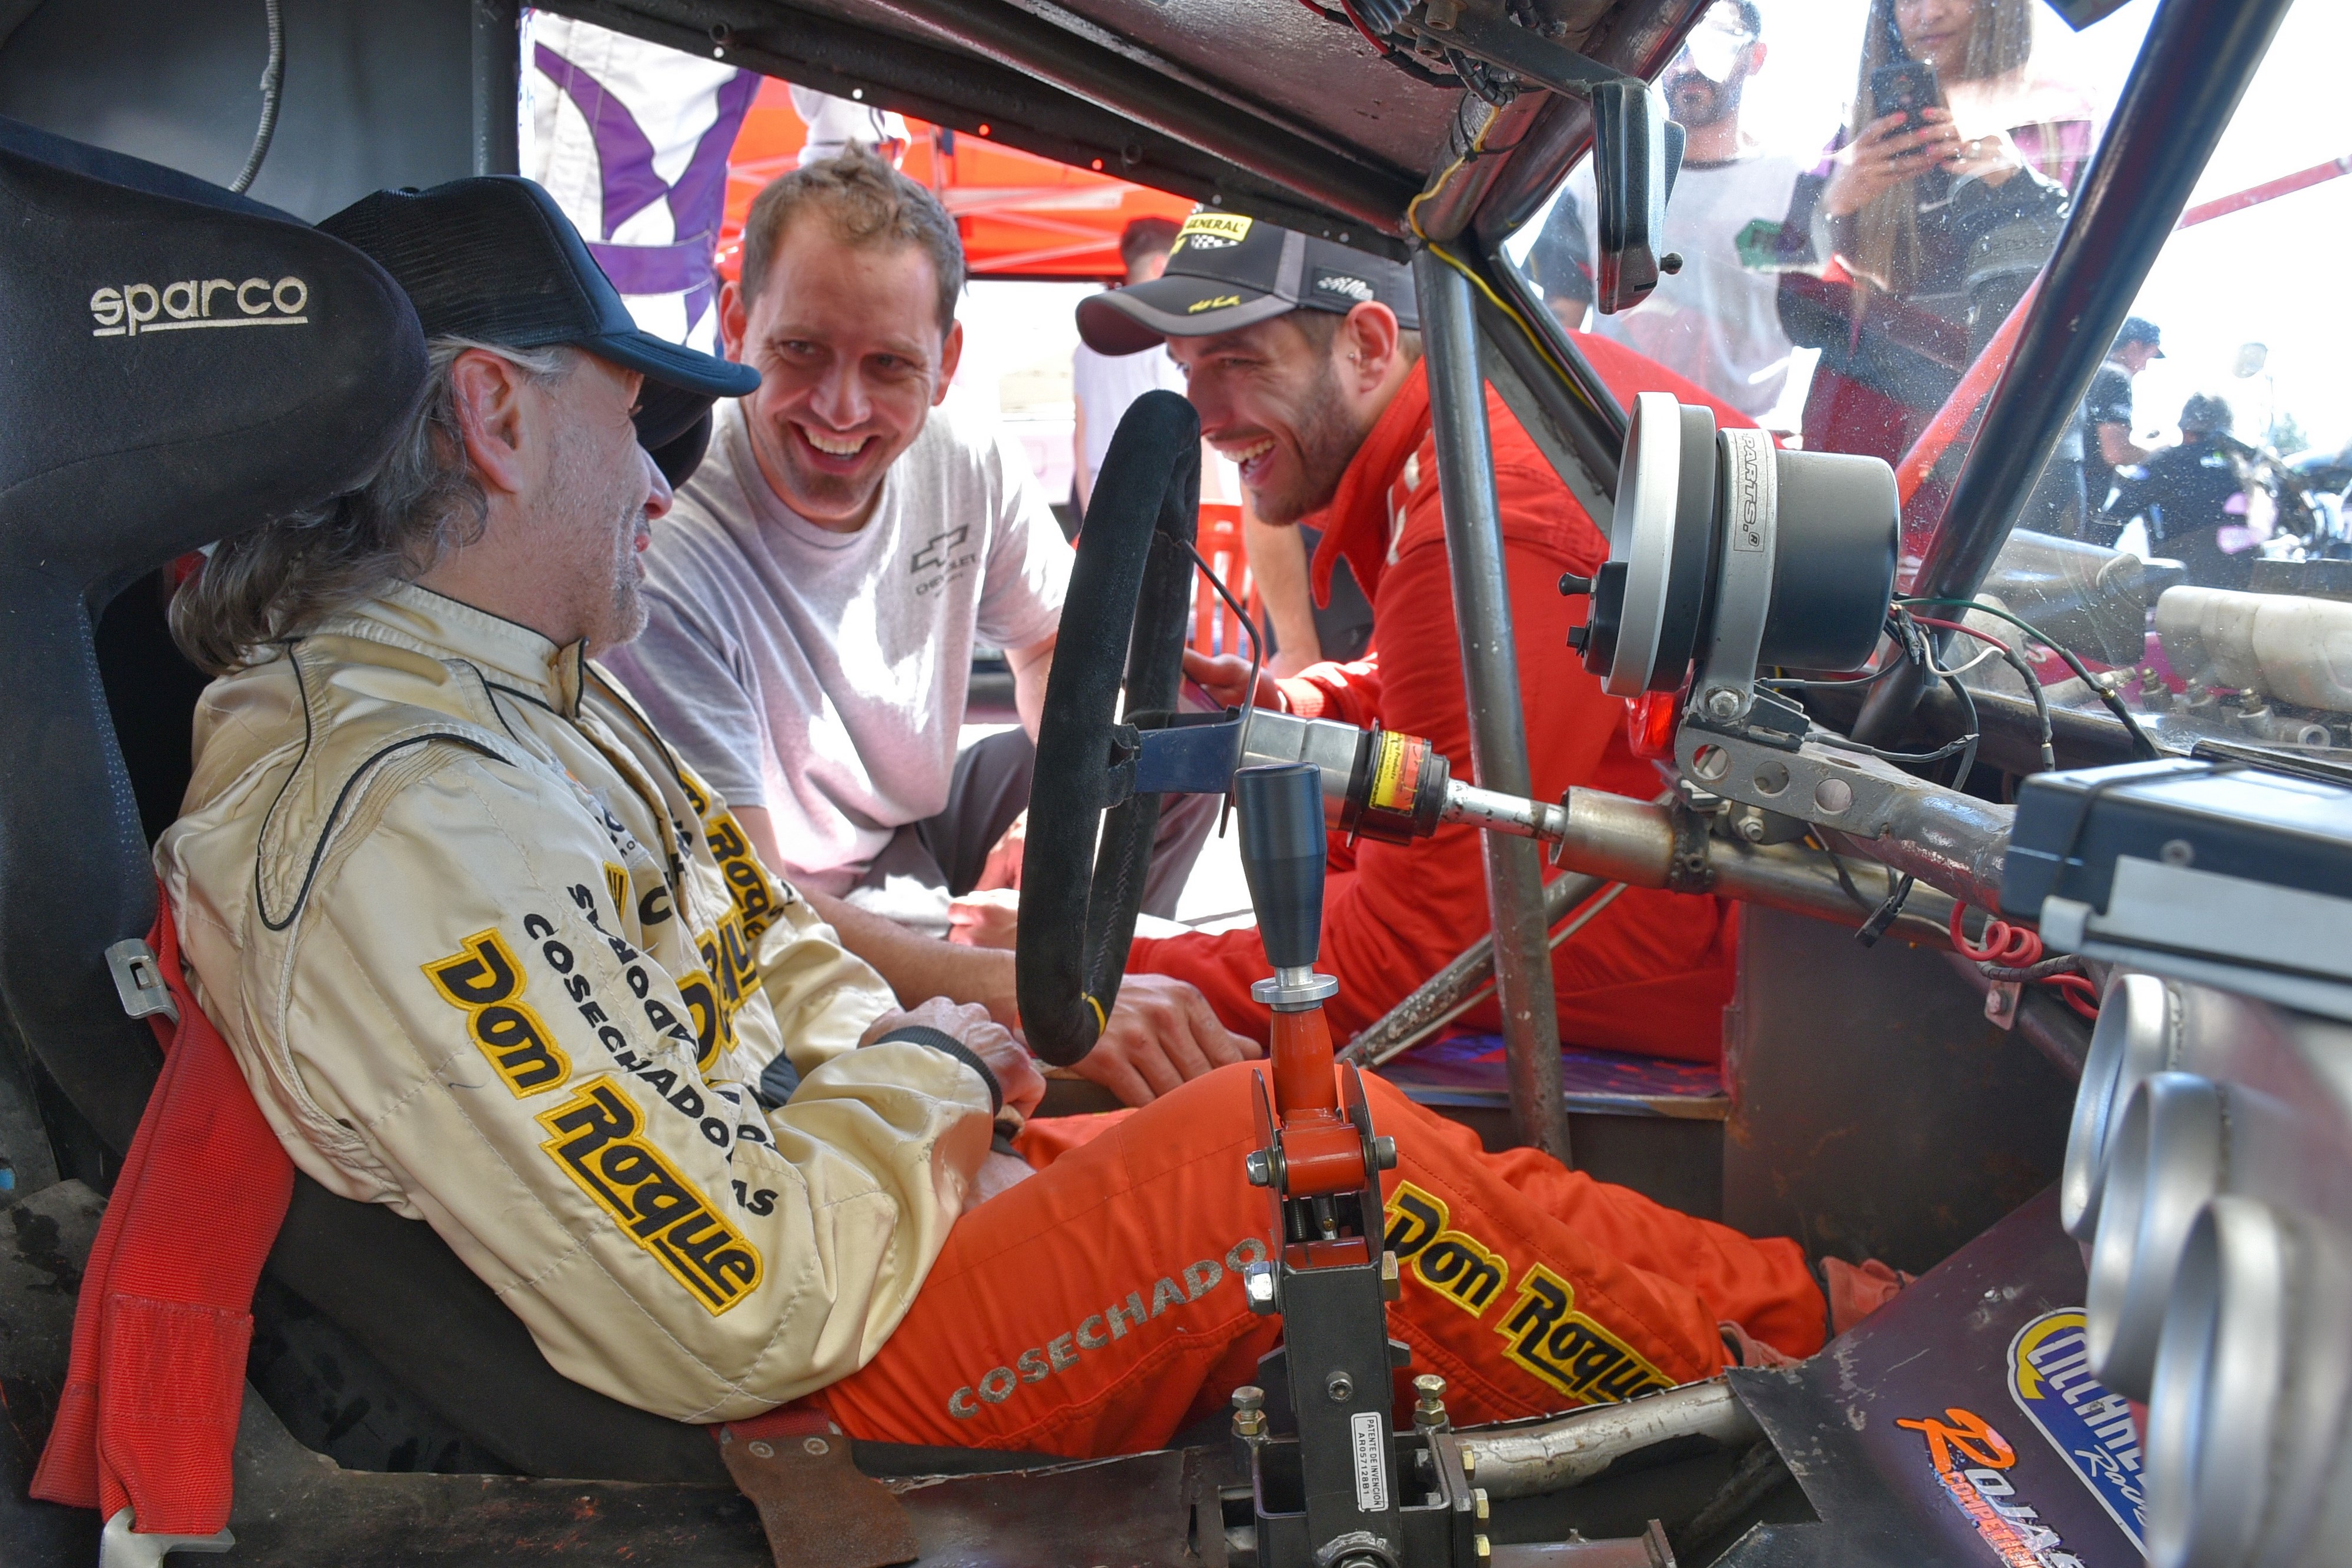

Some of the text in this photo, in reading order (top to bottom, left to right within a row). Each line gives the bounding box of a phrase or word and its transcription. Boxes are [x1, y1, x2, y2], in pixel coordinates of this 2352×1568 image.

[90, 276, 308, 336] sparco
[436, 938, 563, 1090] Don
[550, 1085, 757, 1308] Roque
[1384, 1193, 1502, 1308] Don
[948, 1236, 1267, 1420] COSECHADO
[1358, 1432, 1370, 1495] AR057128B1
[1367, 1419, 1377, 1452] PATENTE
[1370, 1453, 1378, 1463] DE
